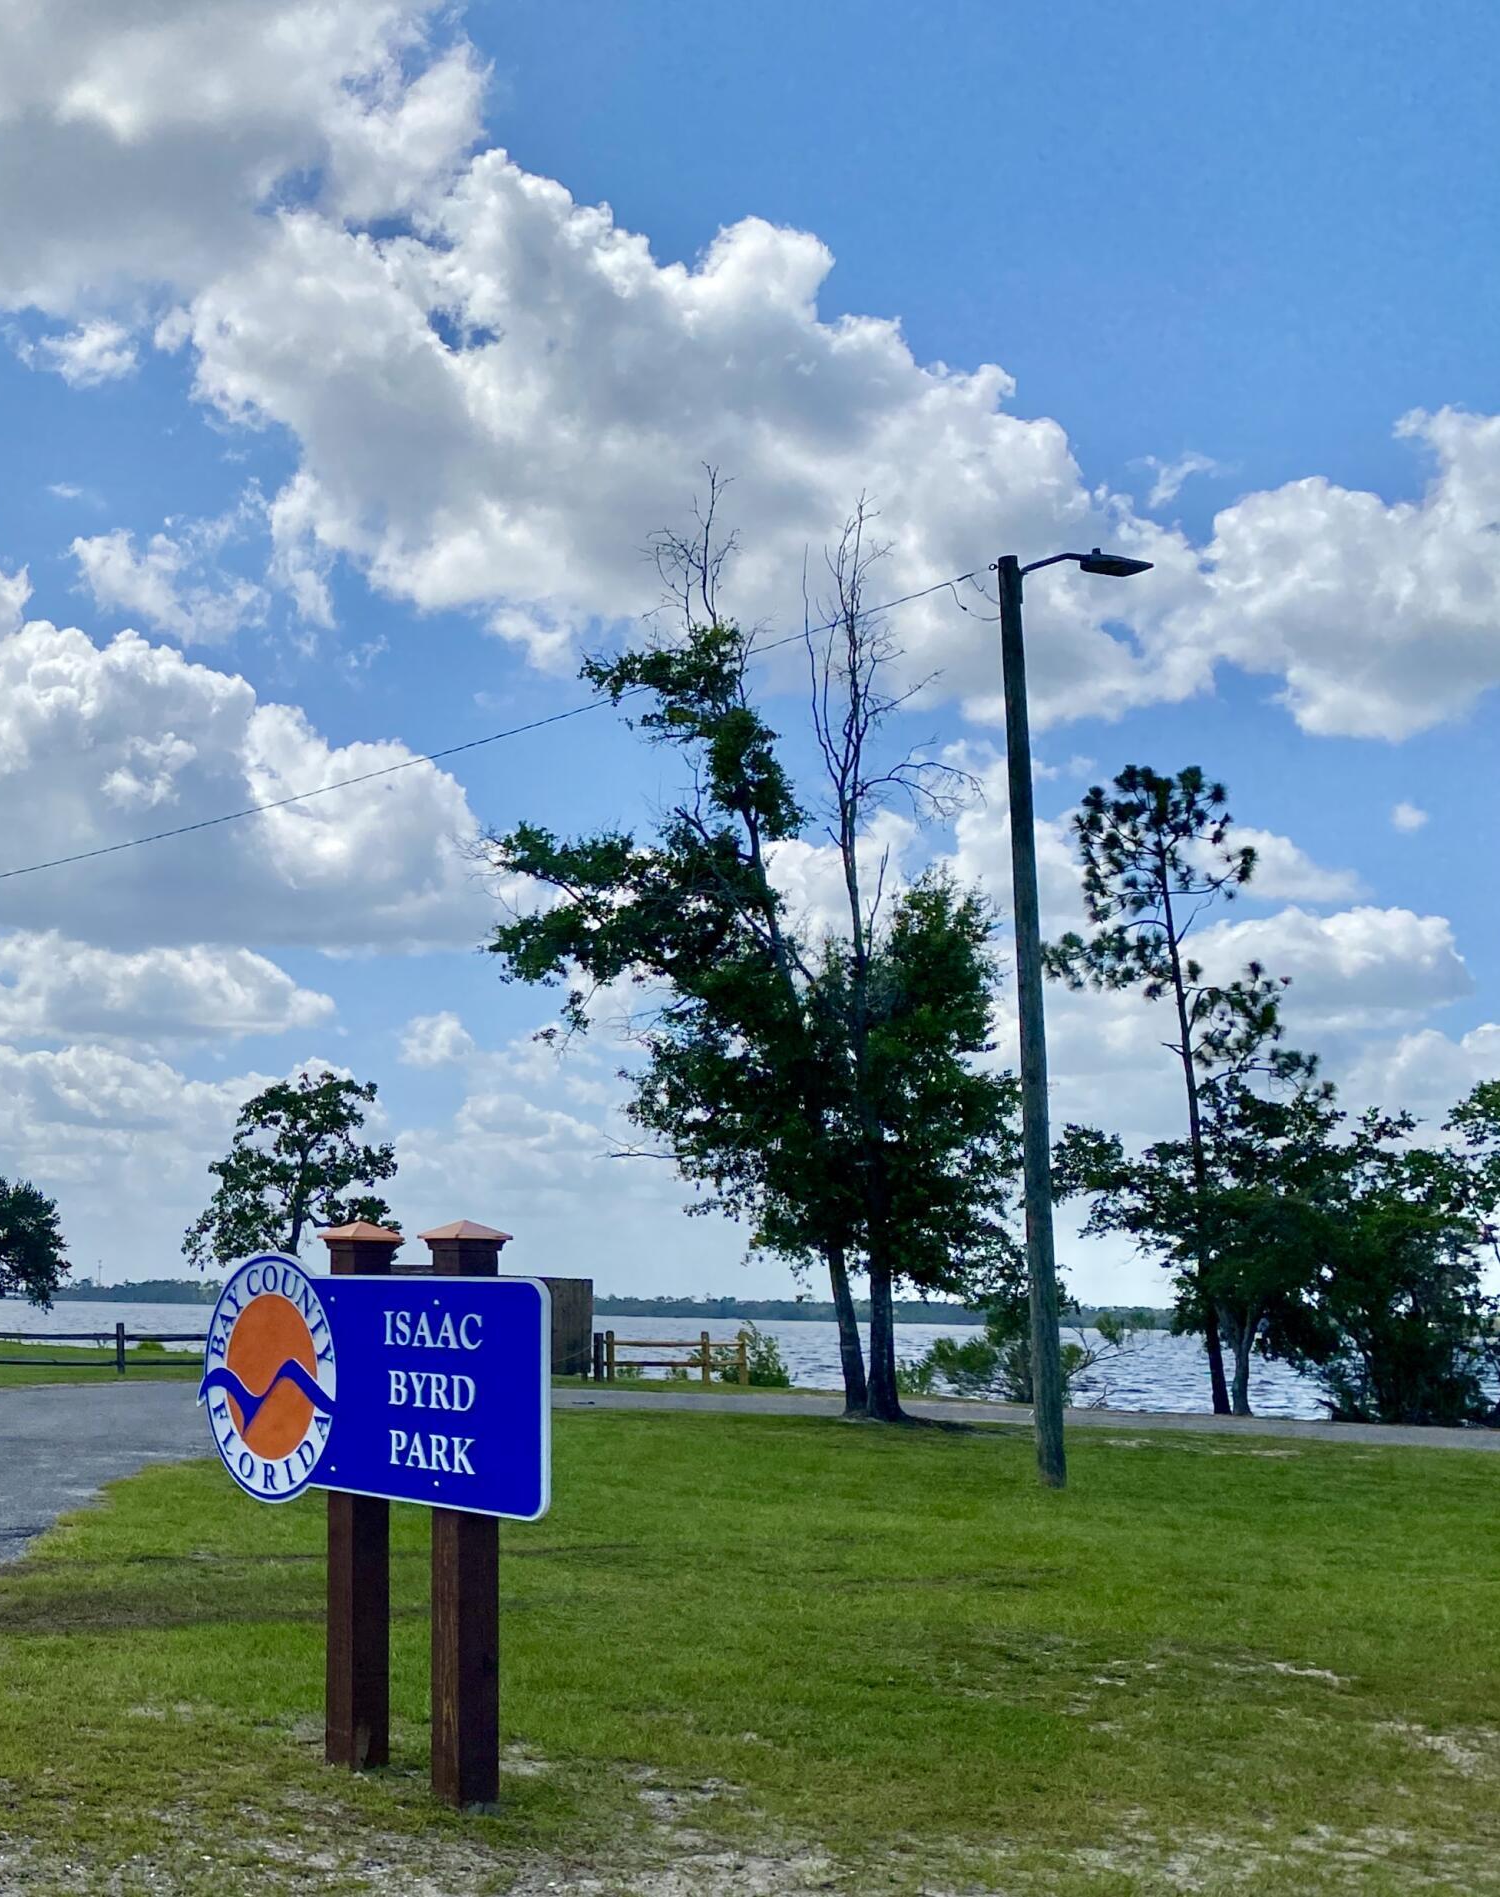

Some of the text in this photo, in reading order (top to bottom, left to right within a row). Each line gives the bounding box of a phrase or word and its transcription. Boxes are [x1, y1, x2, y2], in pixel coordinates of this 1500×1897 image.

[211, 1265, 335, 1364] BAY COUNTY
[383, 1311, 483, 1350] ISAAC
[388, 1370, 476, 1412] BYRD
[212, 1397, 331, 1490] FLORIDA
[388, 1430, 476, 1475] PARK
